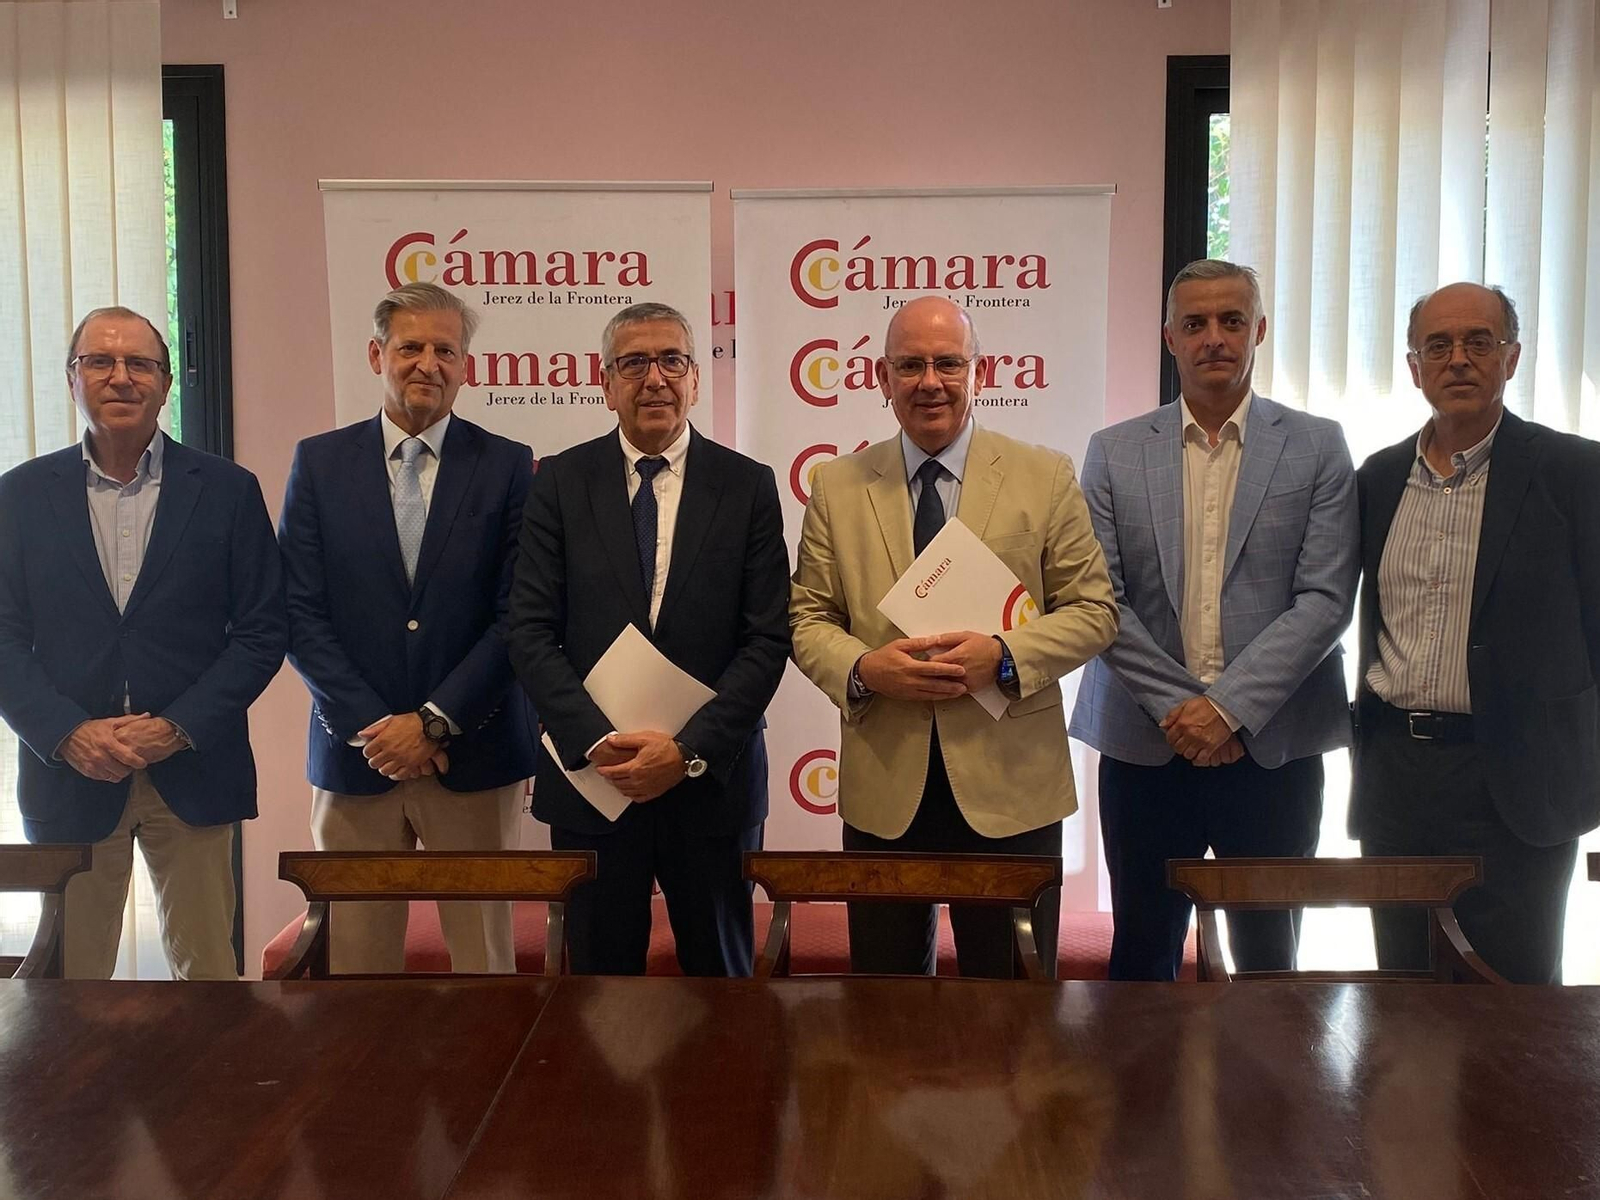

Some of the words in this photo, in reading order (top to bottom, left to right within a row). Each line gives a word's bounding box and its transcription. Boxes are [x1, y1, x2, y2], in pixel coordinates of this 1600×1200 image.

[483, 291, 522, 305] Jerez
[527, 291, 544, 304] de
[549, 291, 562, 304] la
[567, 291, 633, 304] Frontera
[883, 296, 905, 309] Jer
[964, 295, 1030, 308] Frontera
[790, 335, 1049, 408] Cára
[486, 392, 526, 406] Jerez
[533, 392, 547, 404] de
[551, 392, 565, 404] la
[569, 392, 605, 404] Fron
[974, 397, 1029, 408] rontera
